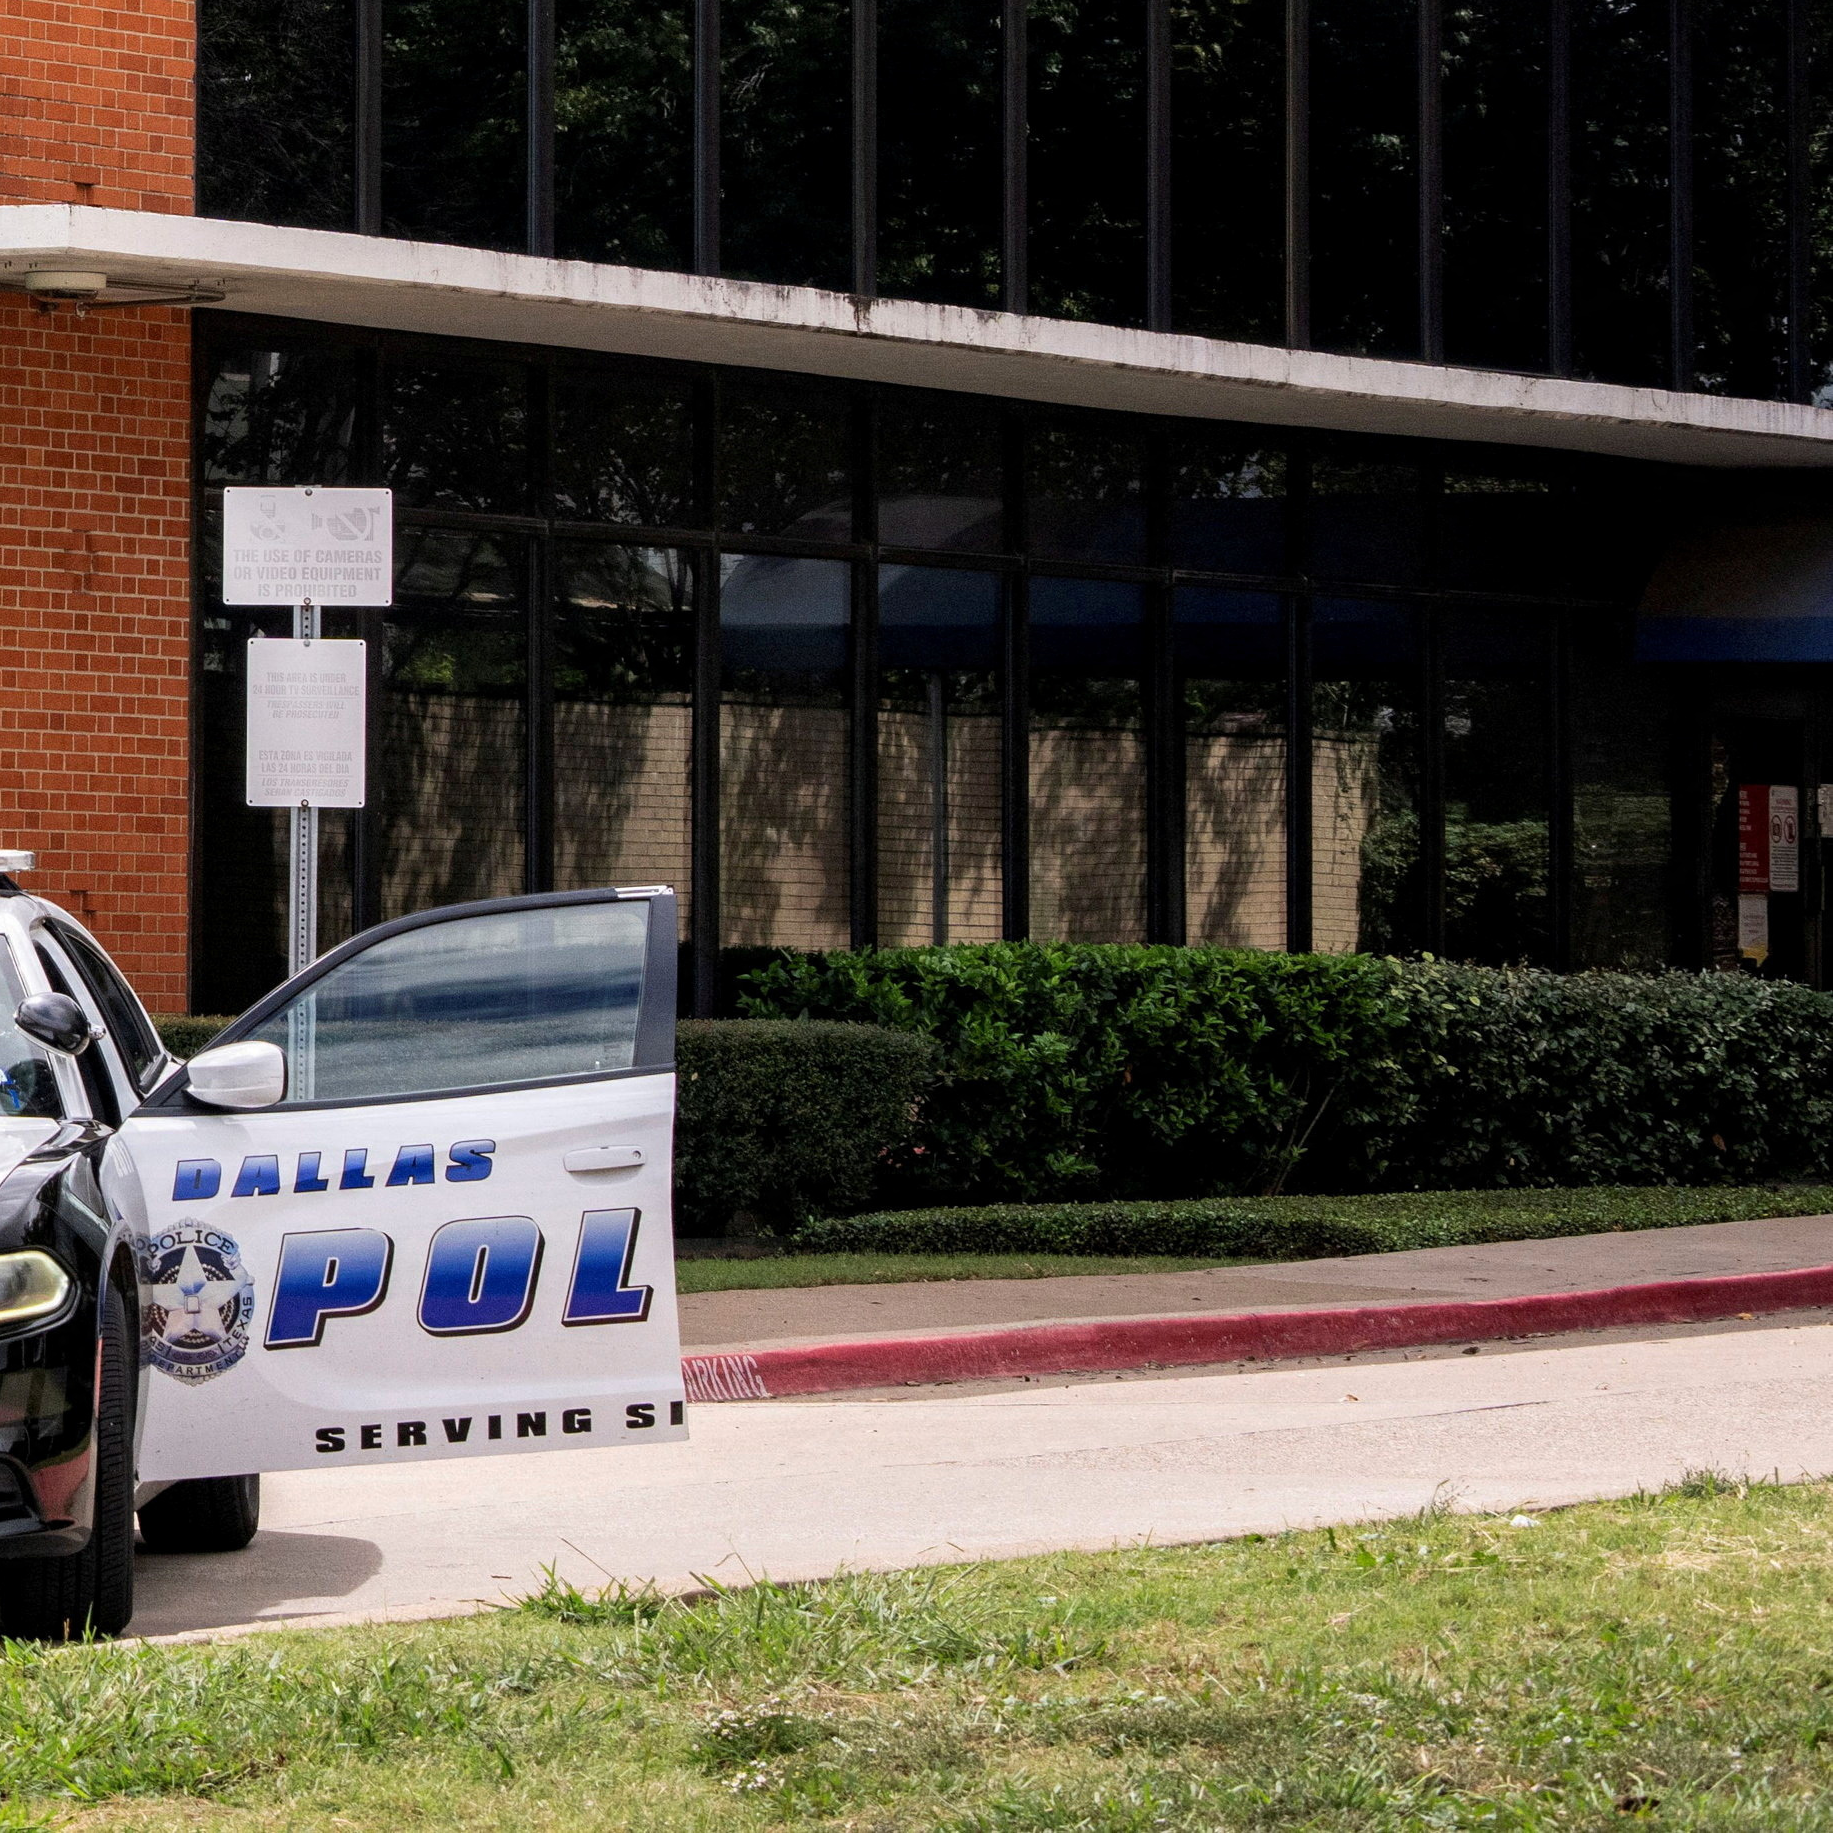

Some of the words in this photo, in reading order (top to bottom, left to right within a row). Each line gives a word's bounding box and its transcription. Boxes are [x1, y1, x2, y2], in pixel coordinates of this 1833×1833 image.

[172, 1139, 496, 1201] DALLAS
[147, 1230, 236, 1258] POLICE
[262, 1207, 653, 1351] POL
[223, 1296, 252, 1347] TEXAS
[148, 1350, 245, 1375] DEPARTMENT
[682, 1356, 769, 1403] ARKING
[316, 1408, 592, 1453] SERVING
